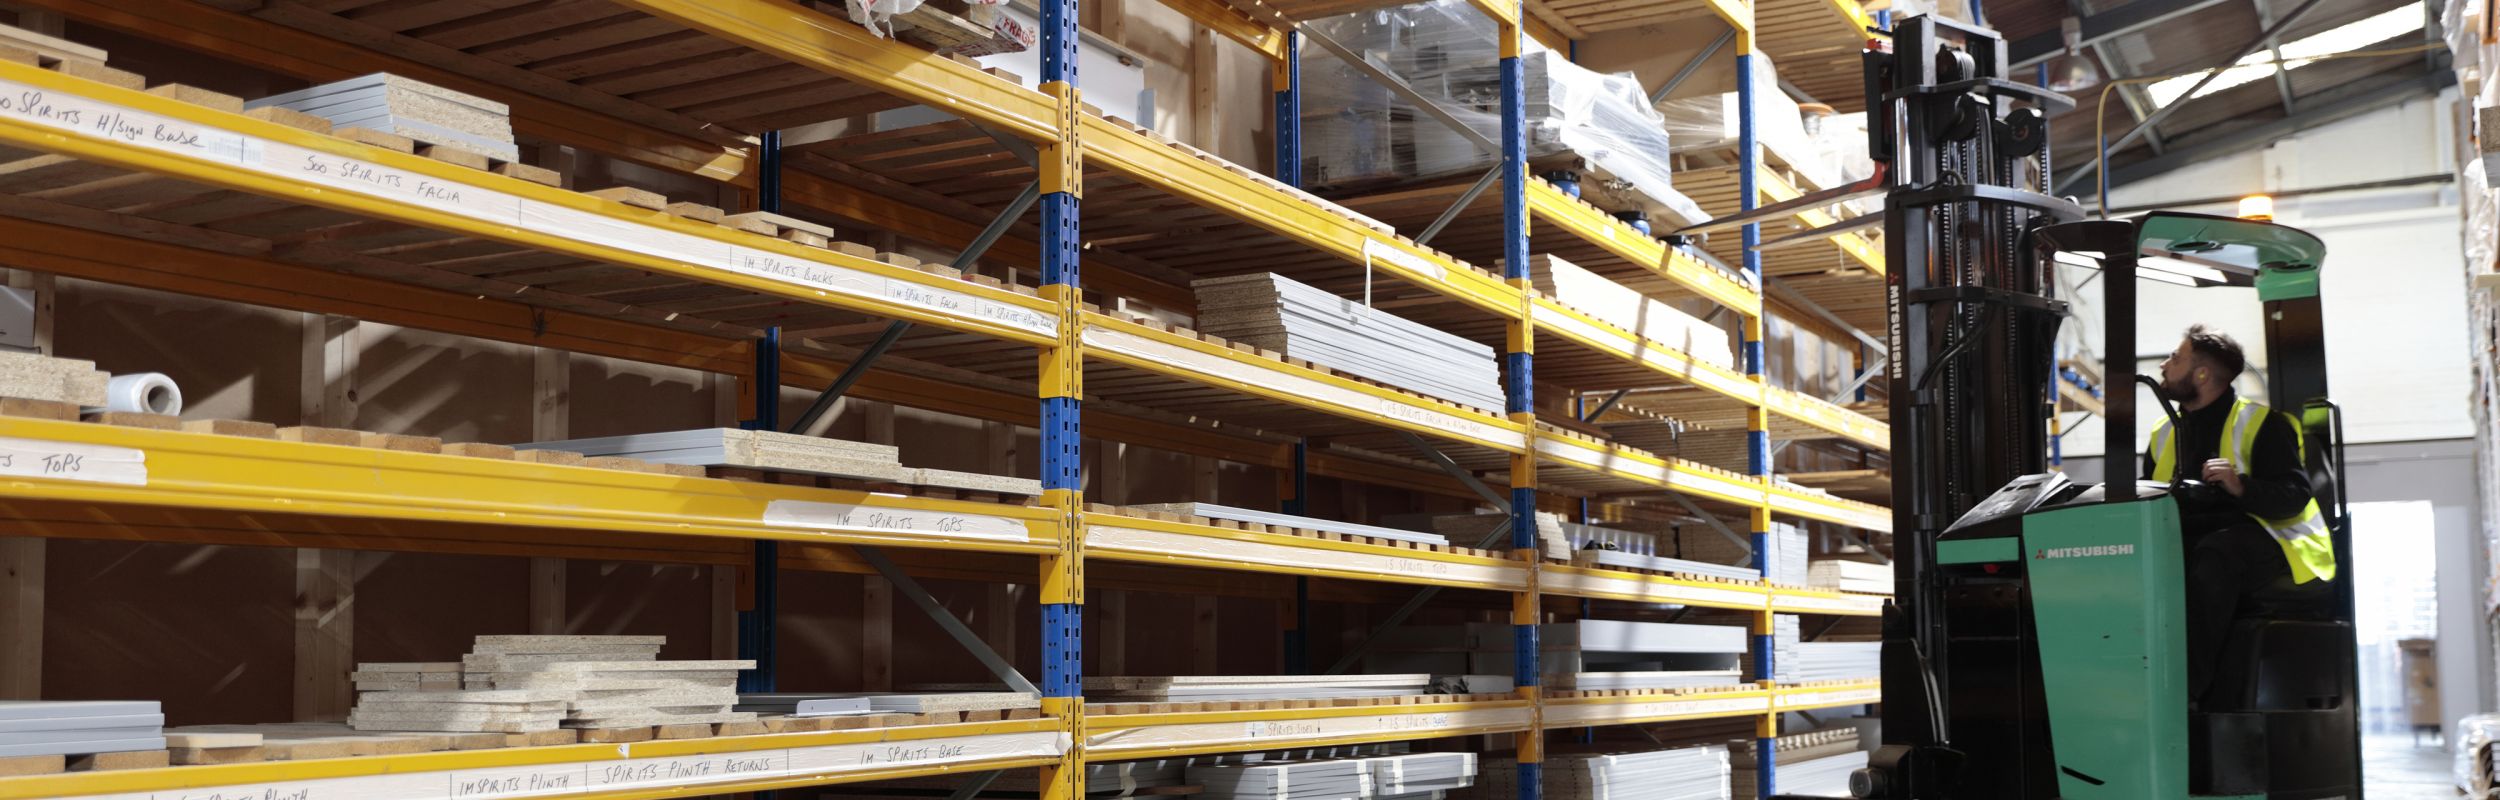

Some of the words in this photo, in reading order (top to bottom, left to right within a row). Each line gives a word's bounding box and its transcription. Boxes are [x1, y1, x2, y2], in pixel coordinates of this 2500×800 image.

[341, 162, 402, 187] SPIRITS
[417, 182, 461, 203] FACIA
[761, 258, 796, 278] SPIRITS
[1890, 285, 1902, 379] MITSUBISHI
[867, 514, 912, 530] SPIRITS
[2047, 544, 2134, 559] MITSUBISHI
[887, 746, 928, 763] SPIRITS
[939, 744, 964, 759] BASE
[602, 763, 657, 784] SPIRITS
[725, 758, 770, 774] RETURNS
